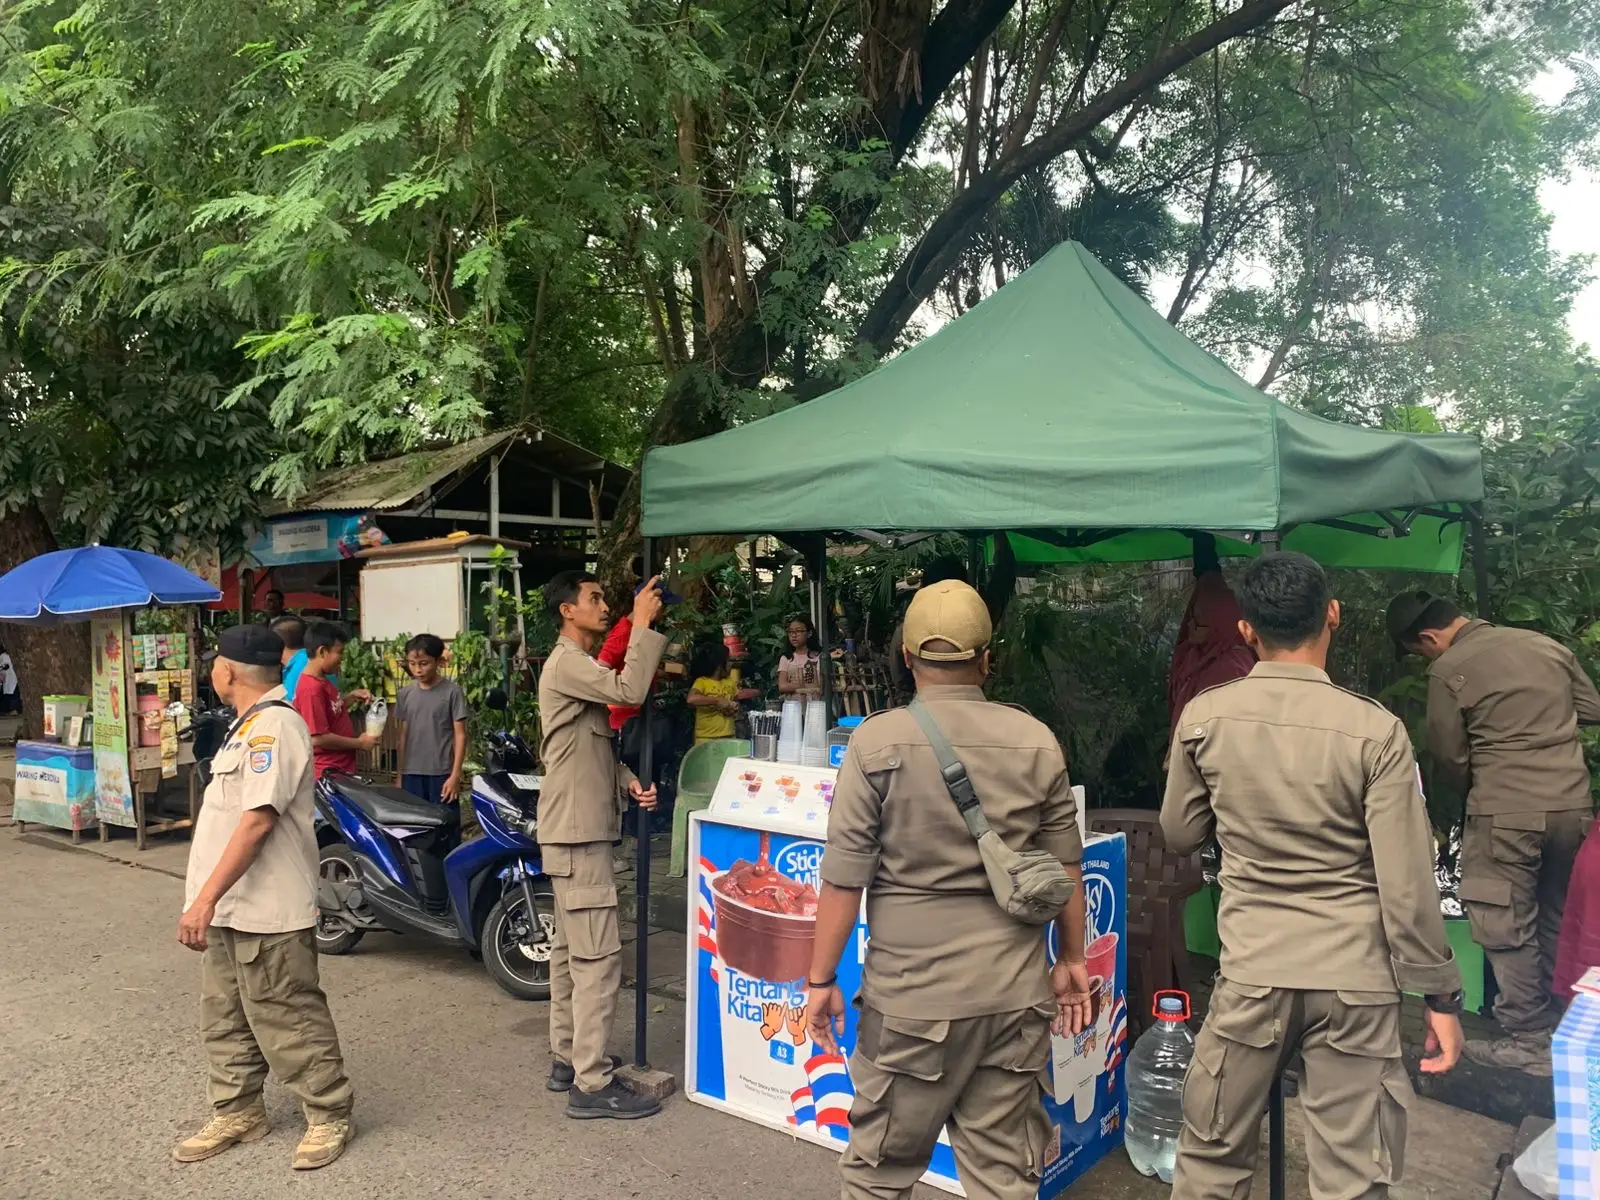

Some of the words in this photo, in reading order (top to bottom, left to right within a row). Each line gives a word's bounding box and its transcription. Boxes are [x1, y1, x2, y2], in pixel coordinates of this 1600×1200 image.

[786, 847, 824, 872] Stick
[1087, 859, 1110, 870] THAILAND
[725, 967, 806, 1007] Tentang
[728, 993, 763, 1023] Kita
